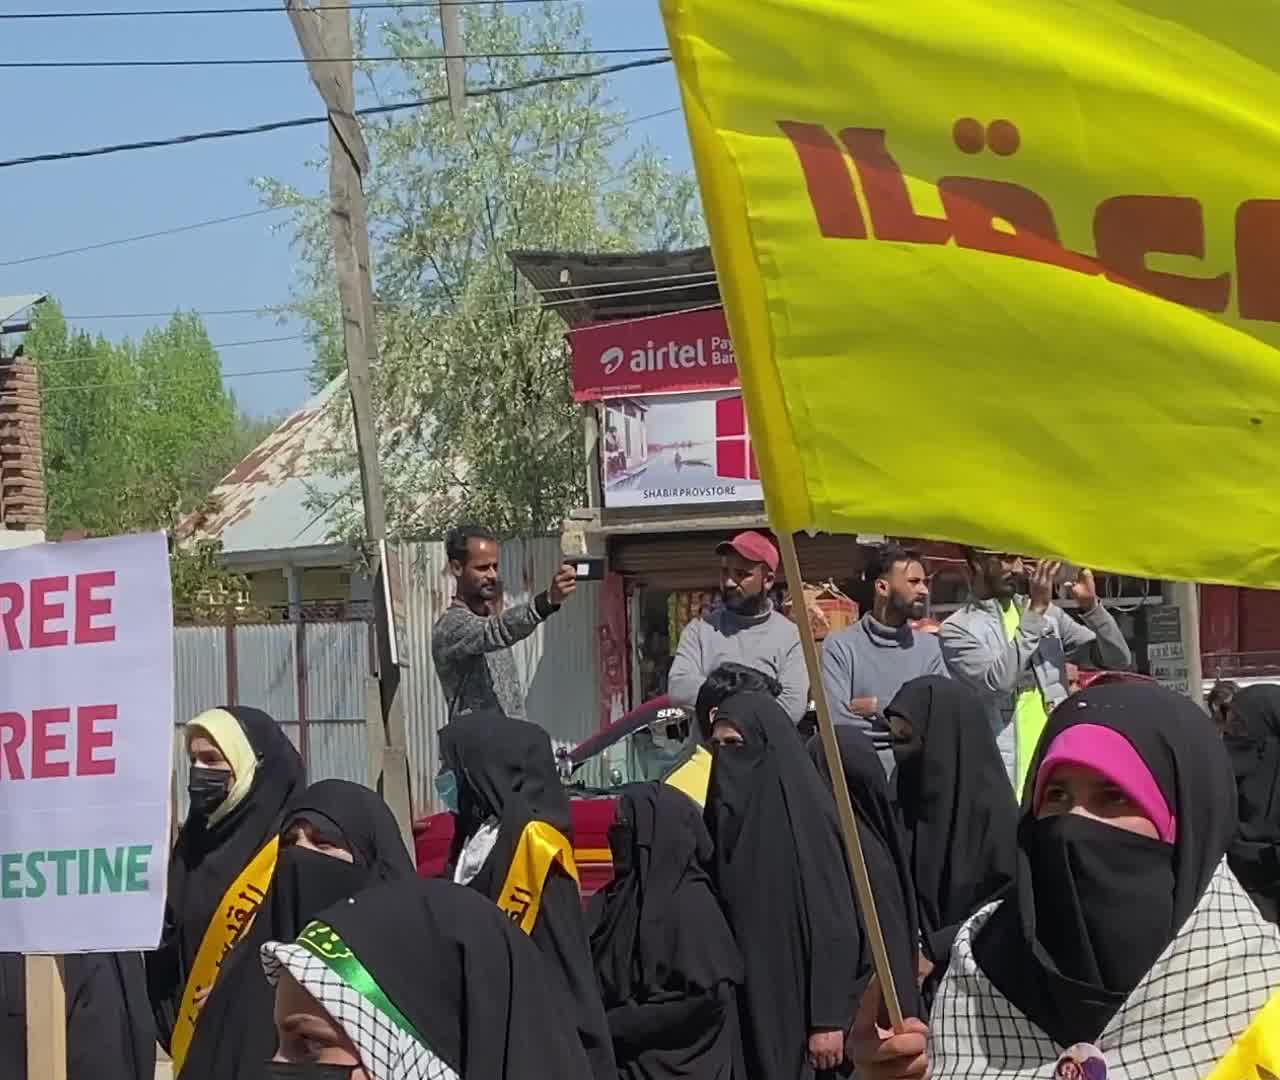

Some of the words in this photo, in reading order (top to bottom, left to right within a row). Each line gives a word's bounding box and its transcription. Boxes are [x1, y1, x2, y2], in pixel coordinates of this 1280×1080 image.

[711, 336, 734, 351] Pay
[630, 338, 707, 373] airtel
[711, 352, 737, 365] Ban
